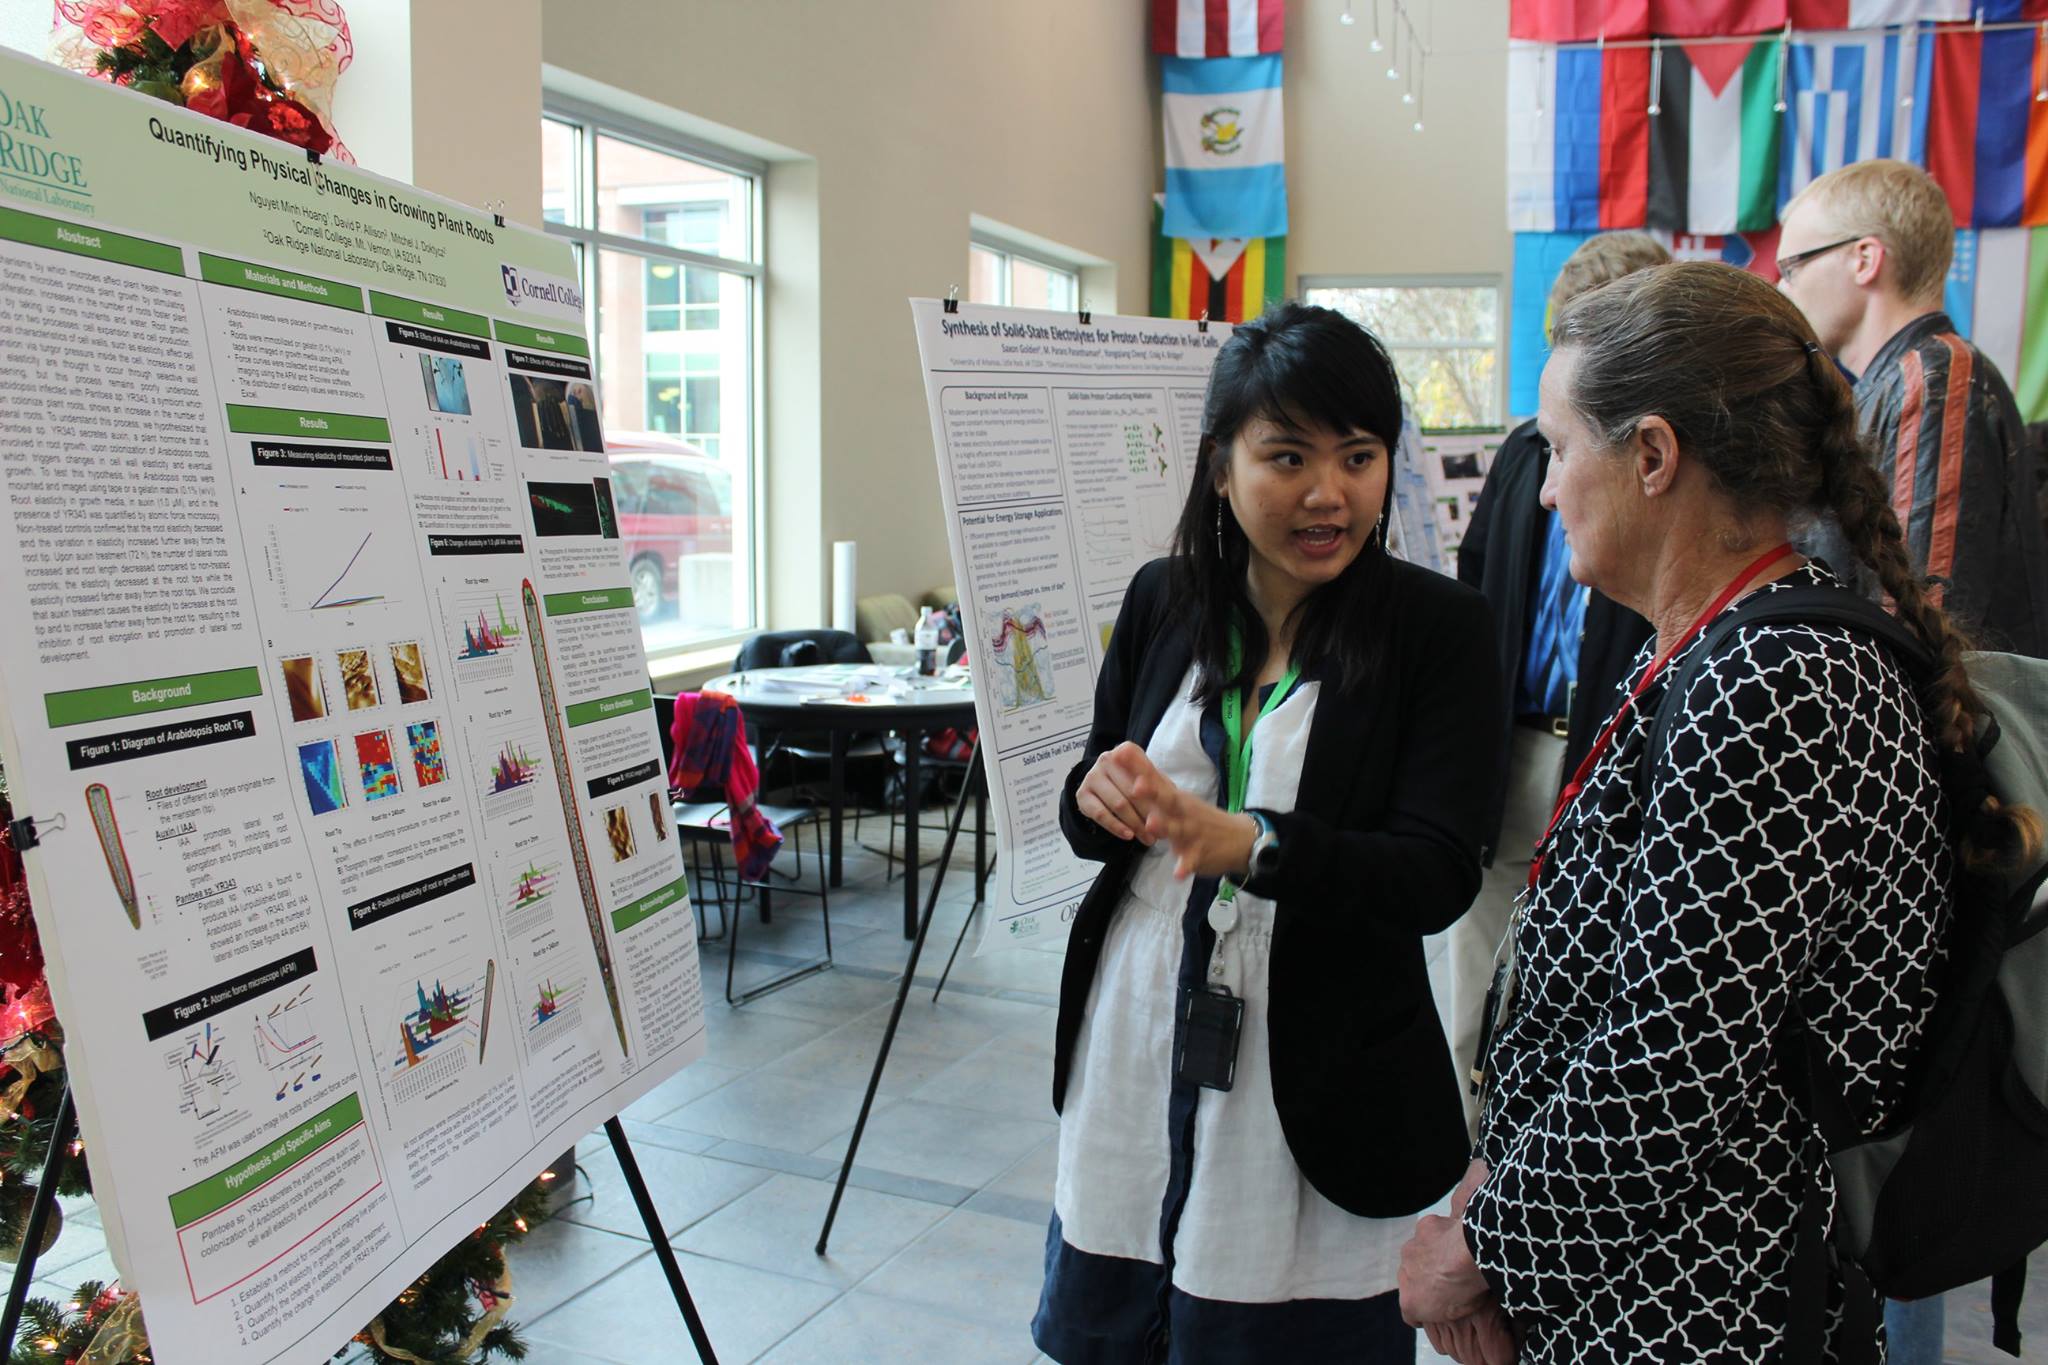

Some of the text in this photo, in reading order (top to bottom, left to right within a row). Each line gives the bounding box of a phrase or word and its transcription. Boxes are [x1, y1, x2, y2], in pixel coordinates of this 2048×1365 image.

[0, 130, 88, 188] RIDGE
[148, 117, 494, 244] Quantifying Physical Changes in Growing Plant Roots
[248, 191, 279, 210] Nguyet
[279, 199, 299, 213] Minh
[333, 214, 354, 231] David
[354, 220, 361, 232] P.
[56, 227, 101, 248] Abstract
[324, 228, 352, 248] College,
[366, 241, 393, 258] Vernon,
[393, 248, 401, 258] IA
[401, 250, 421, 264] 52314
[285, 235, 309, 254] Ridge
[309, 242, 340, 259] National
[342, 250, 379, 272] Laboratory,
[381, 260, 395, 273] Oak
[416, 269, 428, 281] TN
[244, 268, 327, 295] Materials and Methods
[521, 278, 558, 302] Cornell
[421, 307, 444, 321] Results
[941, 319, 989, 337] Synthesis
[990, 323, 1001, 336] of
[1001, 323, 1049, 339] Solid-State
[1049, 327, 1095, 344] Electrolytes
[1095, 329, 1109, 343] for
[1110, 330, 1137, 343] Proton
[1138, 332, 1179, 345] Conduction
[1187, 334, 1201, 347] Fuel
[964, 391, 996, 401] Background
[997, 391, 1007, 399] and
[299, 416, 328, 429] Results
[257, 446, 279, 459] Figure
[286, 449, 315, 461] Measuring
[313, 451, 336, 461] elasticity
[362, 454, 375, 462] plant
[962, 508, 1063, 525] Potential for Energy Storage Applications
[131, 683, 191, 702] Background
[79, 718, 244, 758] Figure 1: Diagram of Arabidopsis Root Tip
[1022, 754, 1036, 766] Solid
[1050, 746, 1062, 755] Fuel
[1061, 742, 1072, 752] Cell
[144, 779, 206, 799] Root development
[175, 890, 203, 904] Pantoea
[215, 878, 236, 891] YR343
[352, 905, 371, 918] Figure
[427, 880, 438, 890] root
[173, 1002, 201, 1019] Figure
[209, 990, 232, 1004] Atomic
[231, 983, 247, 995] force
[247, 970, 279, 988] microscope
[192, 1155, 209, 1167] The
[224, 1118, 331, 1188] Hypothesis and Specific Aims
[201, 1219, 235, 1241] Pantoea
